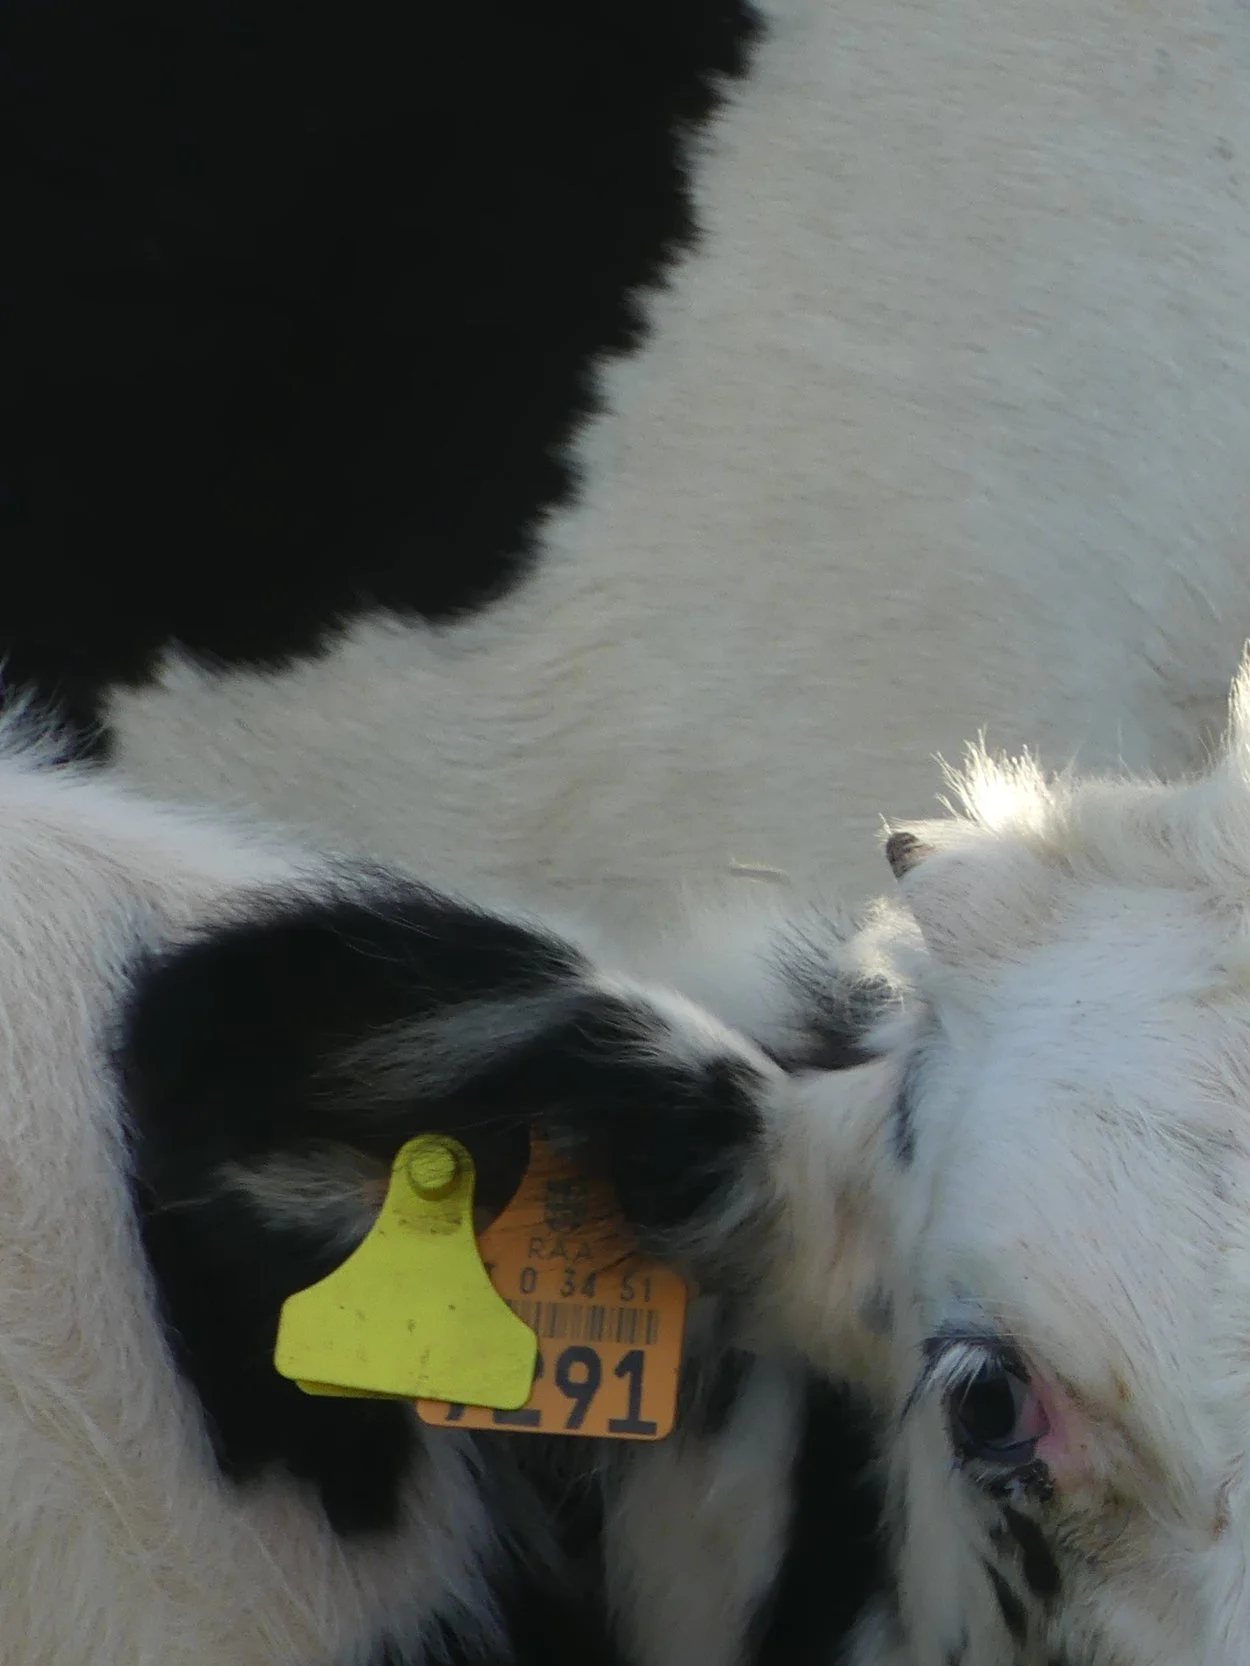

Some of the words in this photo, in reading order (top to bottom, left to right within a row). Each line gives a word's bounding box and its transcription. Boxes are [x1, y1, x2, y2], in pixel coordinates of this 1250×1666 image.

[528, 1237, 593, 1261] RAA
[521, 1266, 538, 1294] 0
[560, 1267, 597, 1297] 34
[620, 1274, 652, 1302] 51
[446, 1346, 658, 1434] 91
